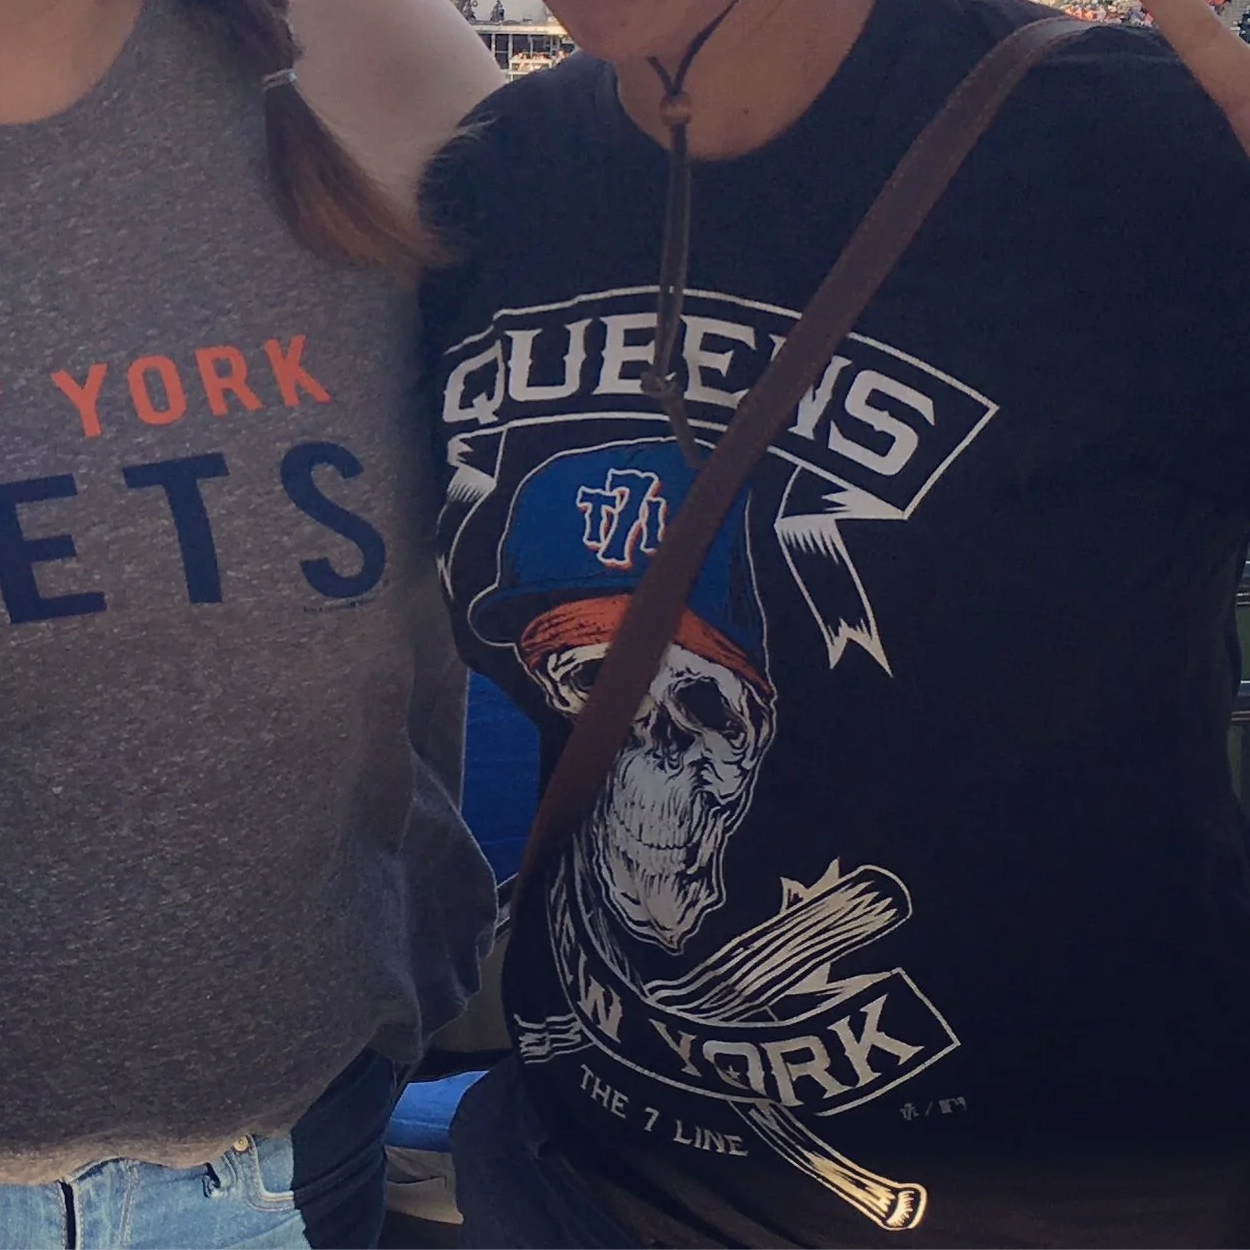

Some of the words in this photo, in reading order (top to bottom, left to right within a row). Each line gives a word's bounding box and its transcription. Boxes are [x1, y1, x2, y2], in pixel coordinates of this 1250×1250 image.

[52, 335, 332, 438] YORK
[442, 313, 936, 476] QUEENS
[648, 993, 925, 1106] YORK
[579, 1063, 630, 1120] THE
[643, 1106, 660, 1132] 7
[672, 1119, 749, 1157] LINE
